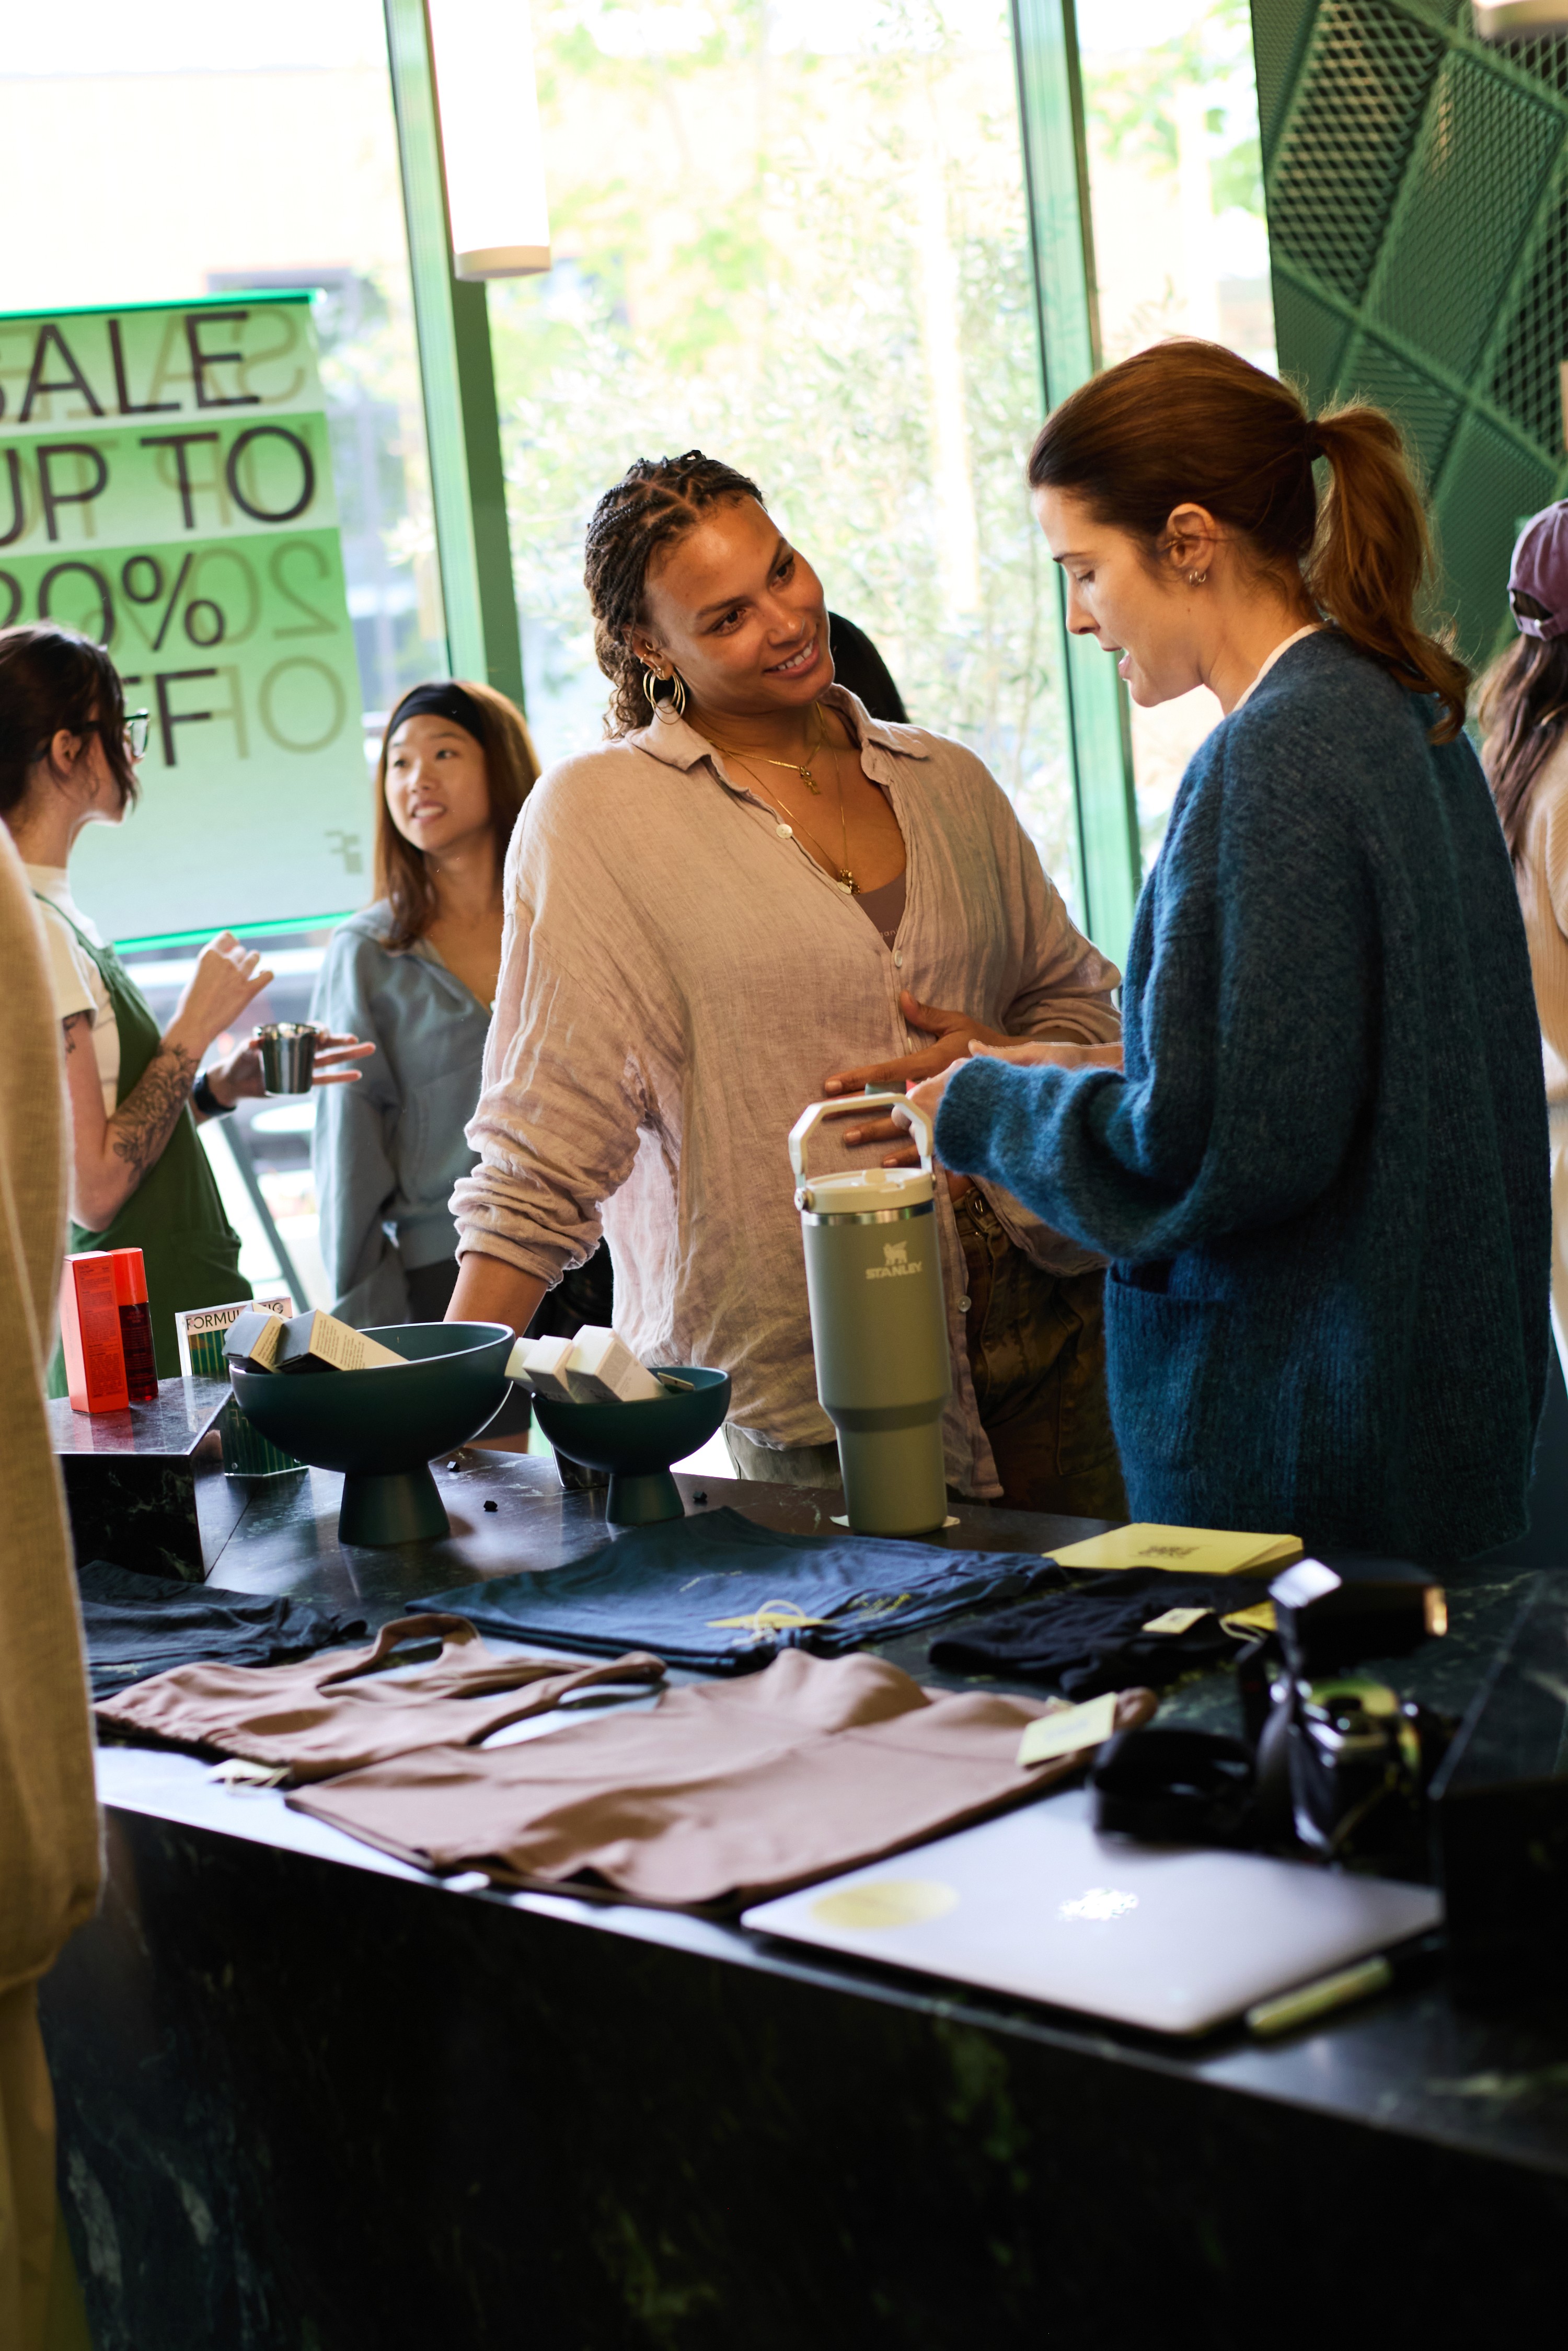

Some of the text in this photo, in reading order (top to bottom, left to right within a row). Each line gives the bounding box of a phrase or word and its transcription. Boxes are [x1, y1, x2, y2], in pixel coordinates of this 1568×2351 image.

[0, 312, 259, 422] ALE
[140, 427, 314, 528] TO
[866, 1261, 922, 1280] STANLEY
